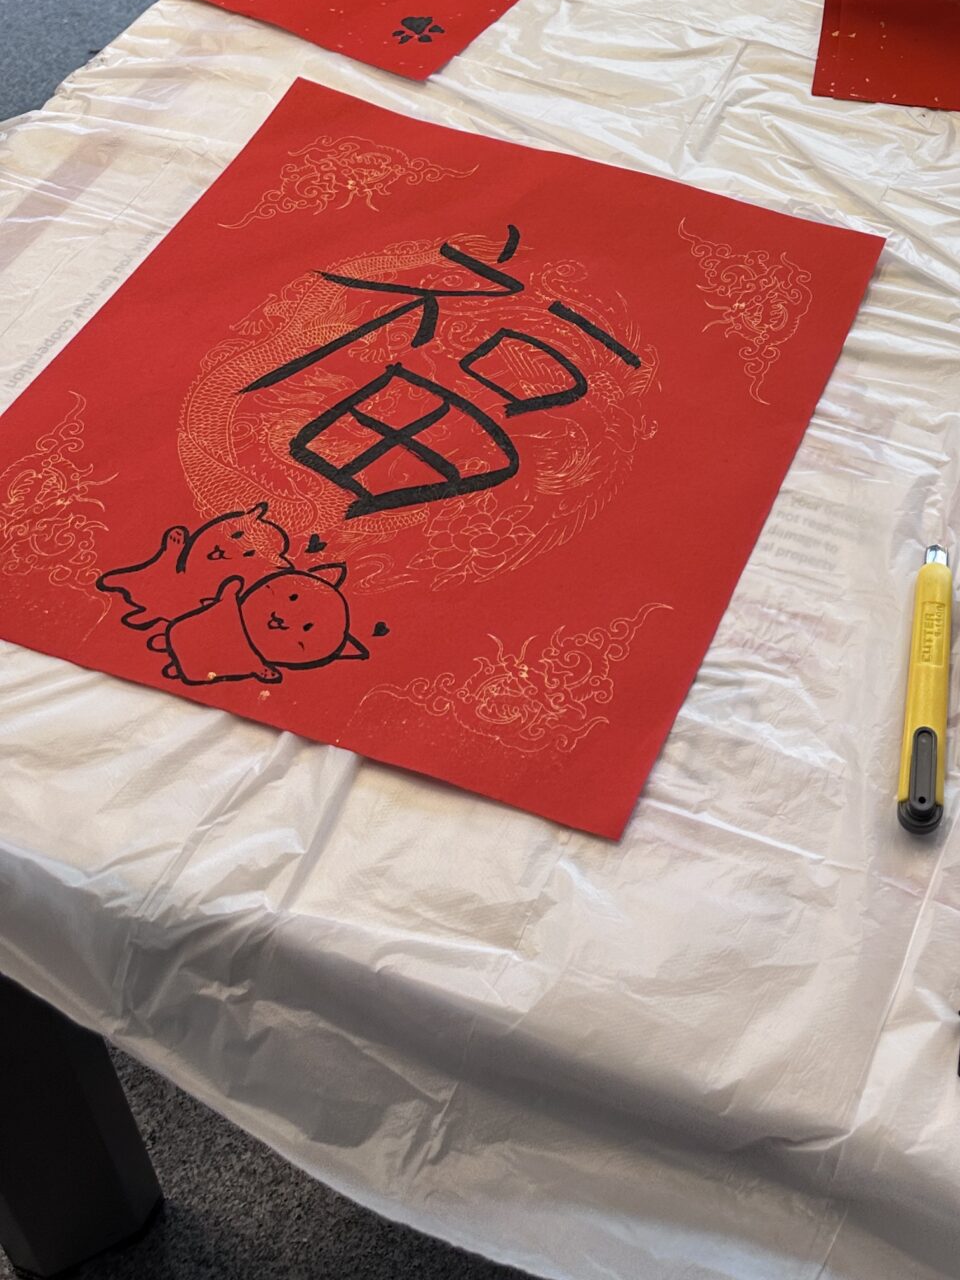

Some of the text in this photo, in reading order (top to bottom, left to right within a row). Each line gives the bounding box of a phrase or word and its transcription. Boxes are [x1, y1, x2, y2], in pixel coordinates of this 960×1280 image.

[75, 291, 100, 322] your
[6, 318, 75, 388] cooperation
[238, 224, 643, 522] 福
